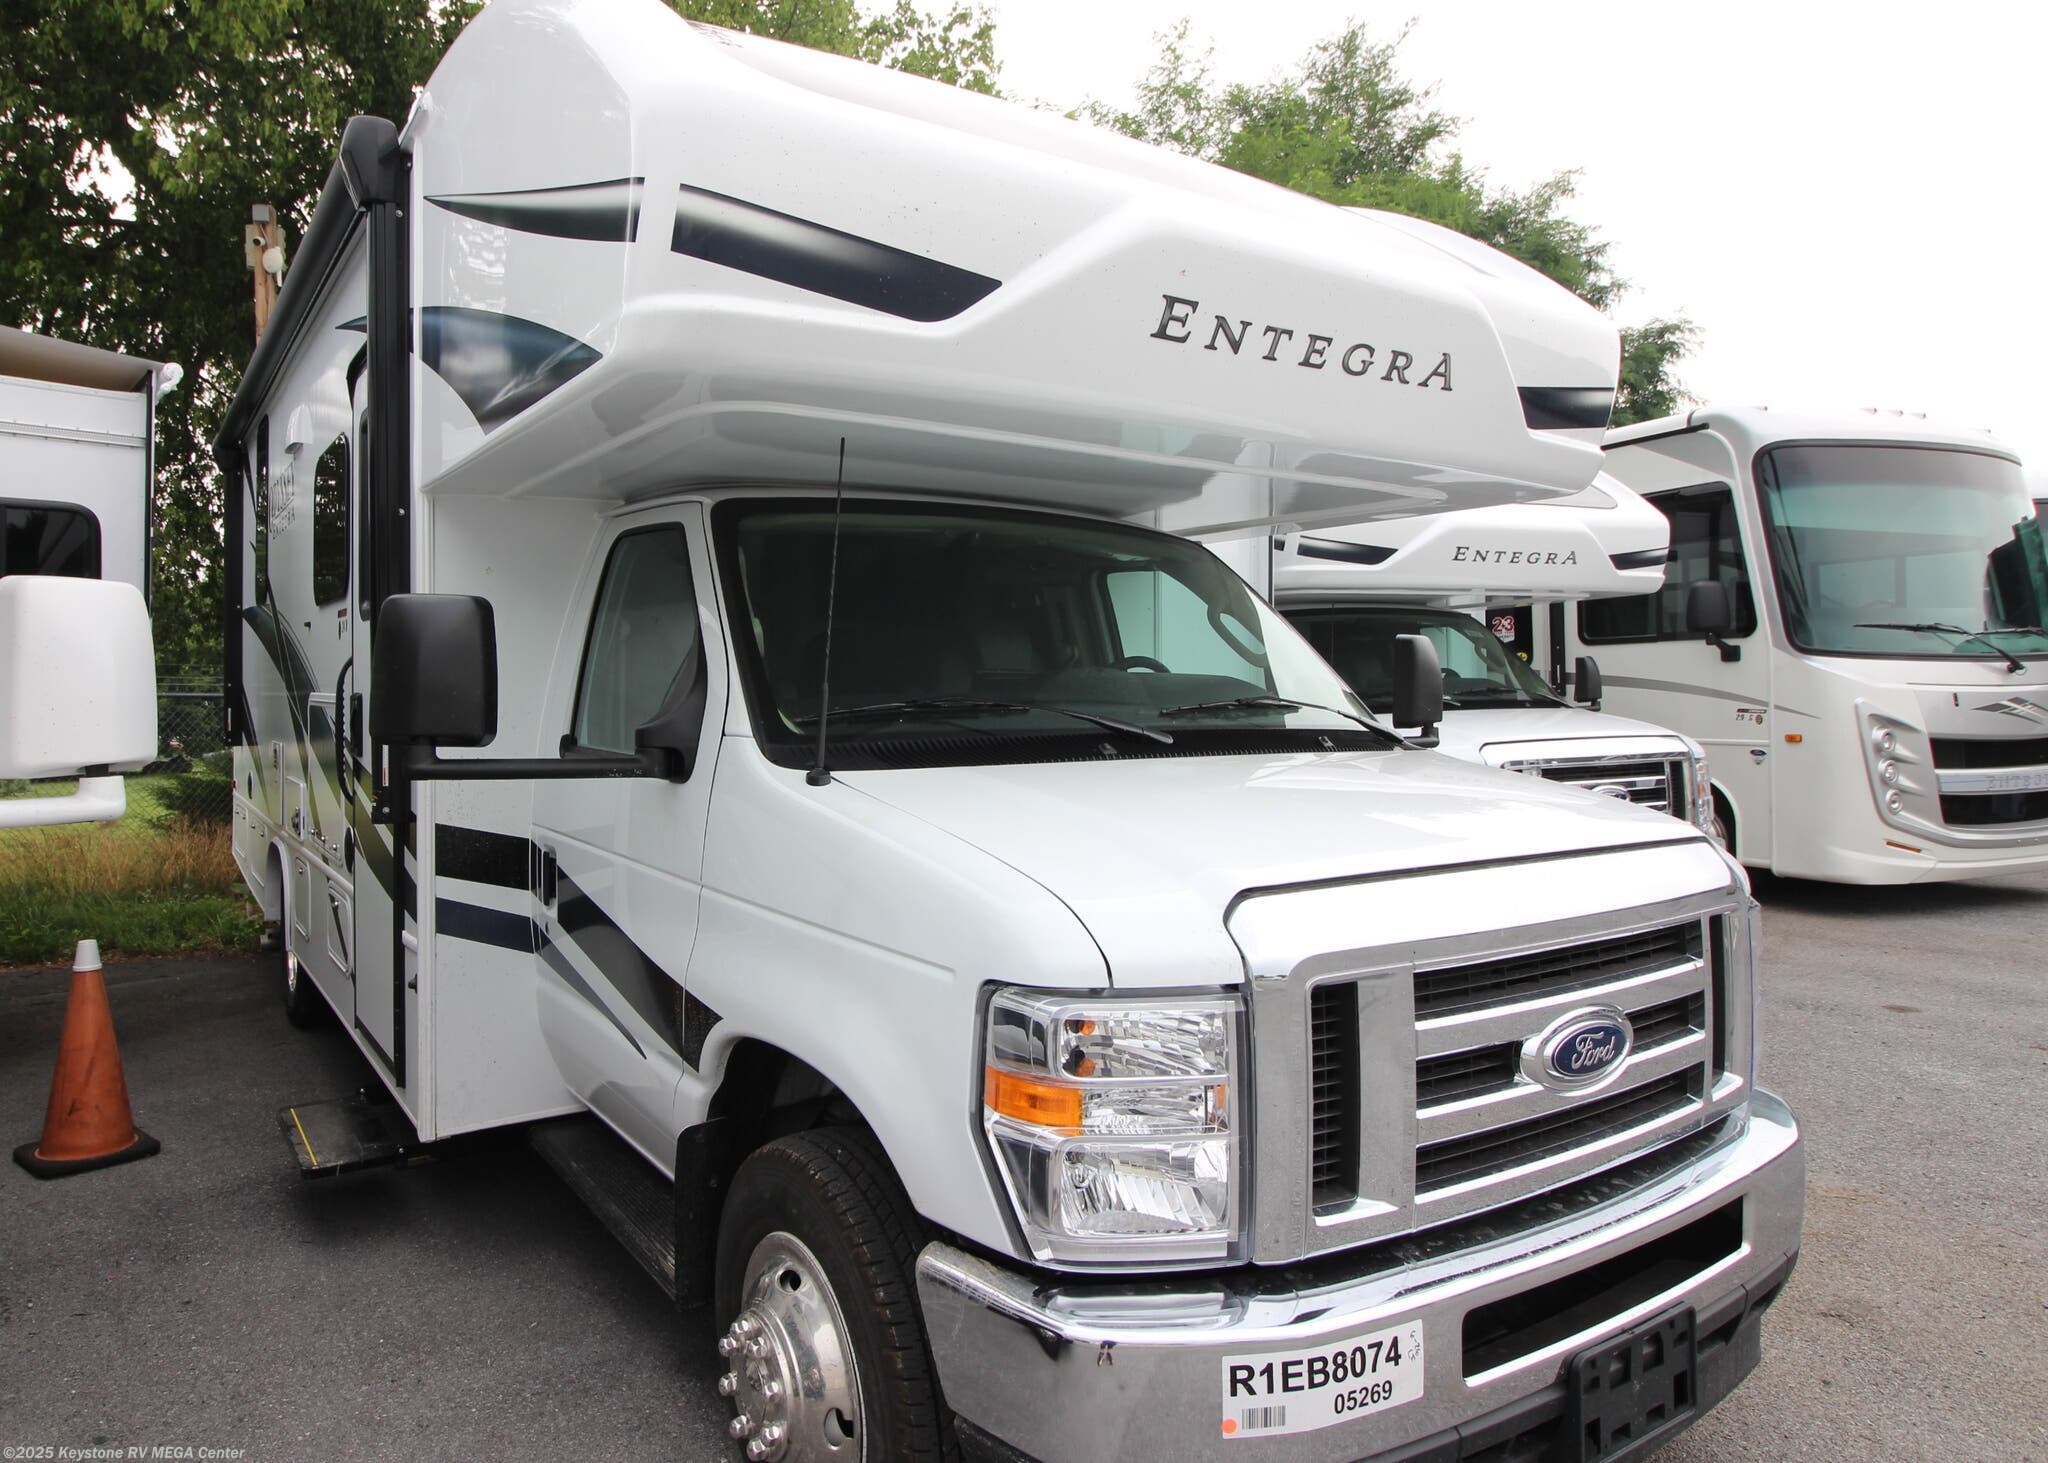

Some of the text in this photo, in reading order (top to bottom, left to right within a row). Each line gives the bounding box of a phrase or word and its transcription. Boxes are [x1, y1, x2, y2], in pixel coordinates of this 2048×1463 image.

[1150, 294, 1453, 392] ENTEGRA
[1452, 546, 1577, 565] ENTEGRA
[1571, 1031, 1616, 1070] Ford
[1229, 1336, 1402, 1398] R1EB8074
[1334, 1380, 1393, 1414] 05269
